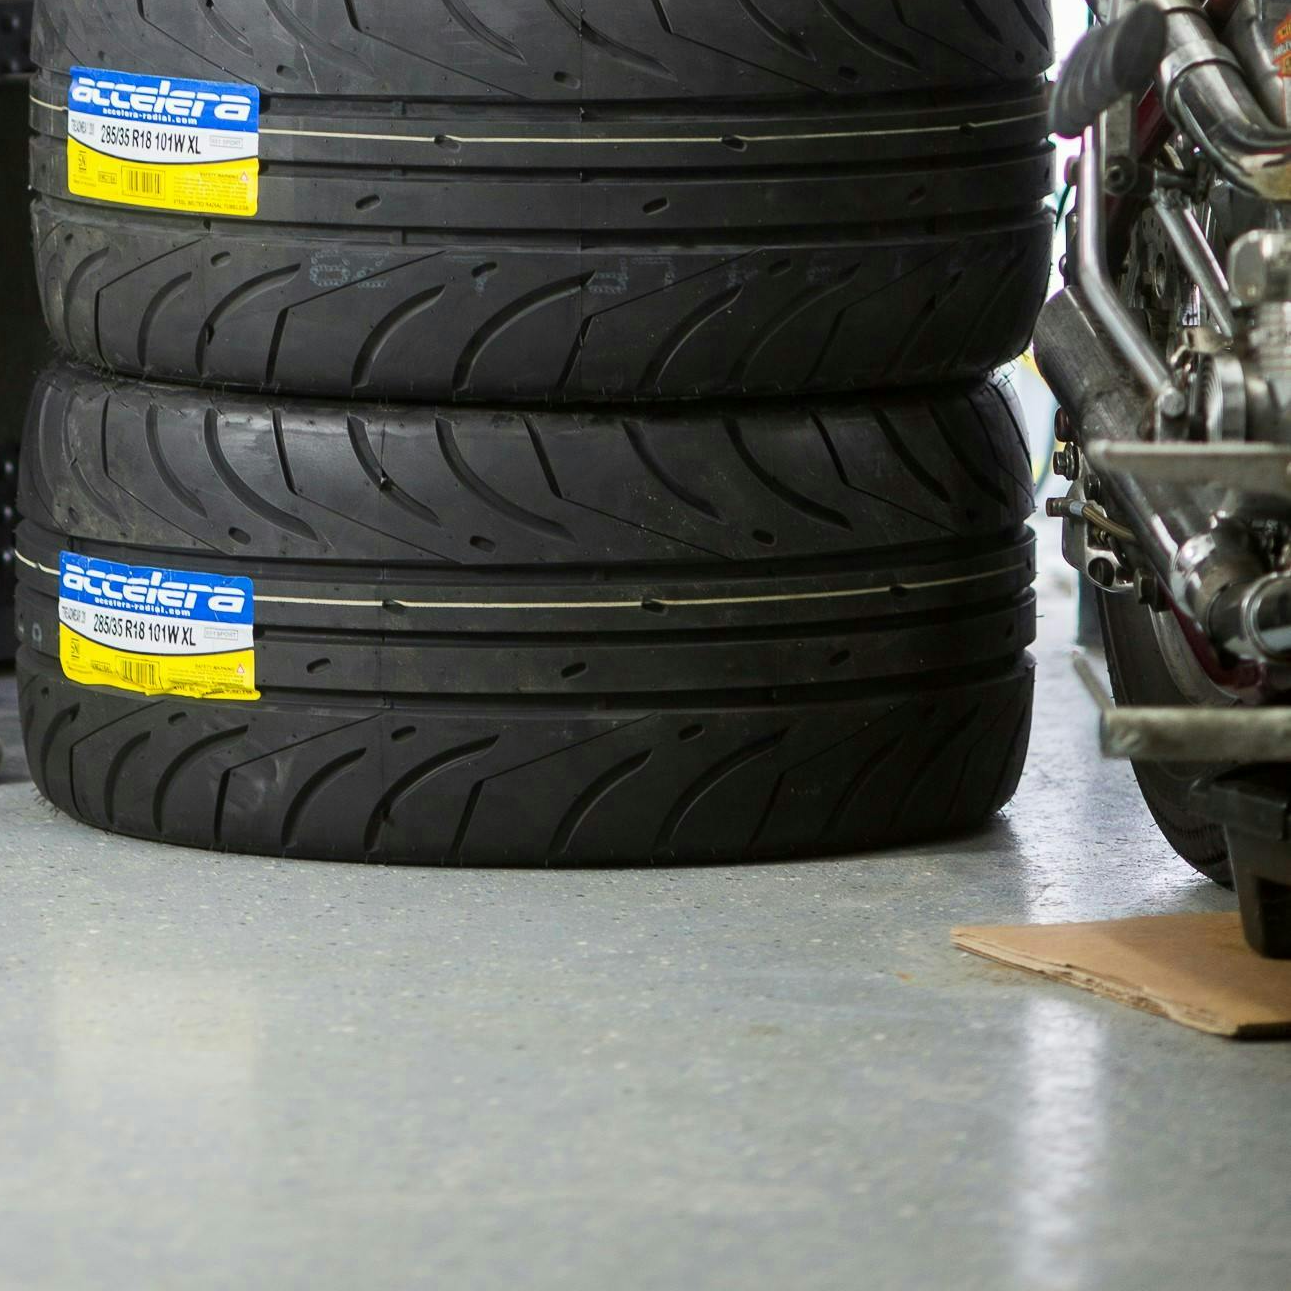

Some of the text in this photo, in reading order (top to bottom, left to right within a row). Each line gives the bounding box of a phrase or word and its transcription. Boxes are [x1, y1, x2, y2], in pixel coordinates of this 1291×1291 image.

[71, 77, 252, 121] accelera
[101, 124, 130, 147] 285/35
[132, 129, 152, 150] R18
[155, 132, 186, 154] 101W
[188, 134, 201, 155] XL
[63, 563, 245, 613] accelera
[93, 613, 123, 637] 285/35
[125, 619, 145, 640] R18
[148, 622, 179, 645] 101W
[181, 626, 196, 646] XL
